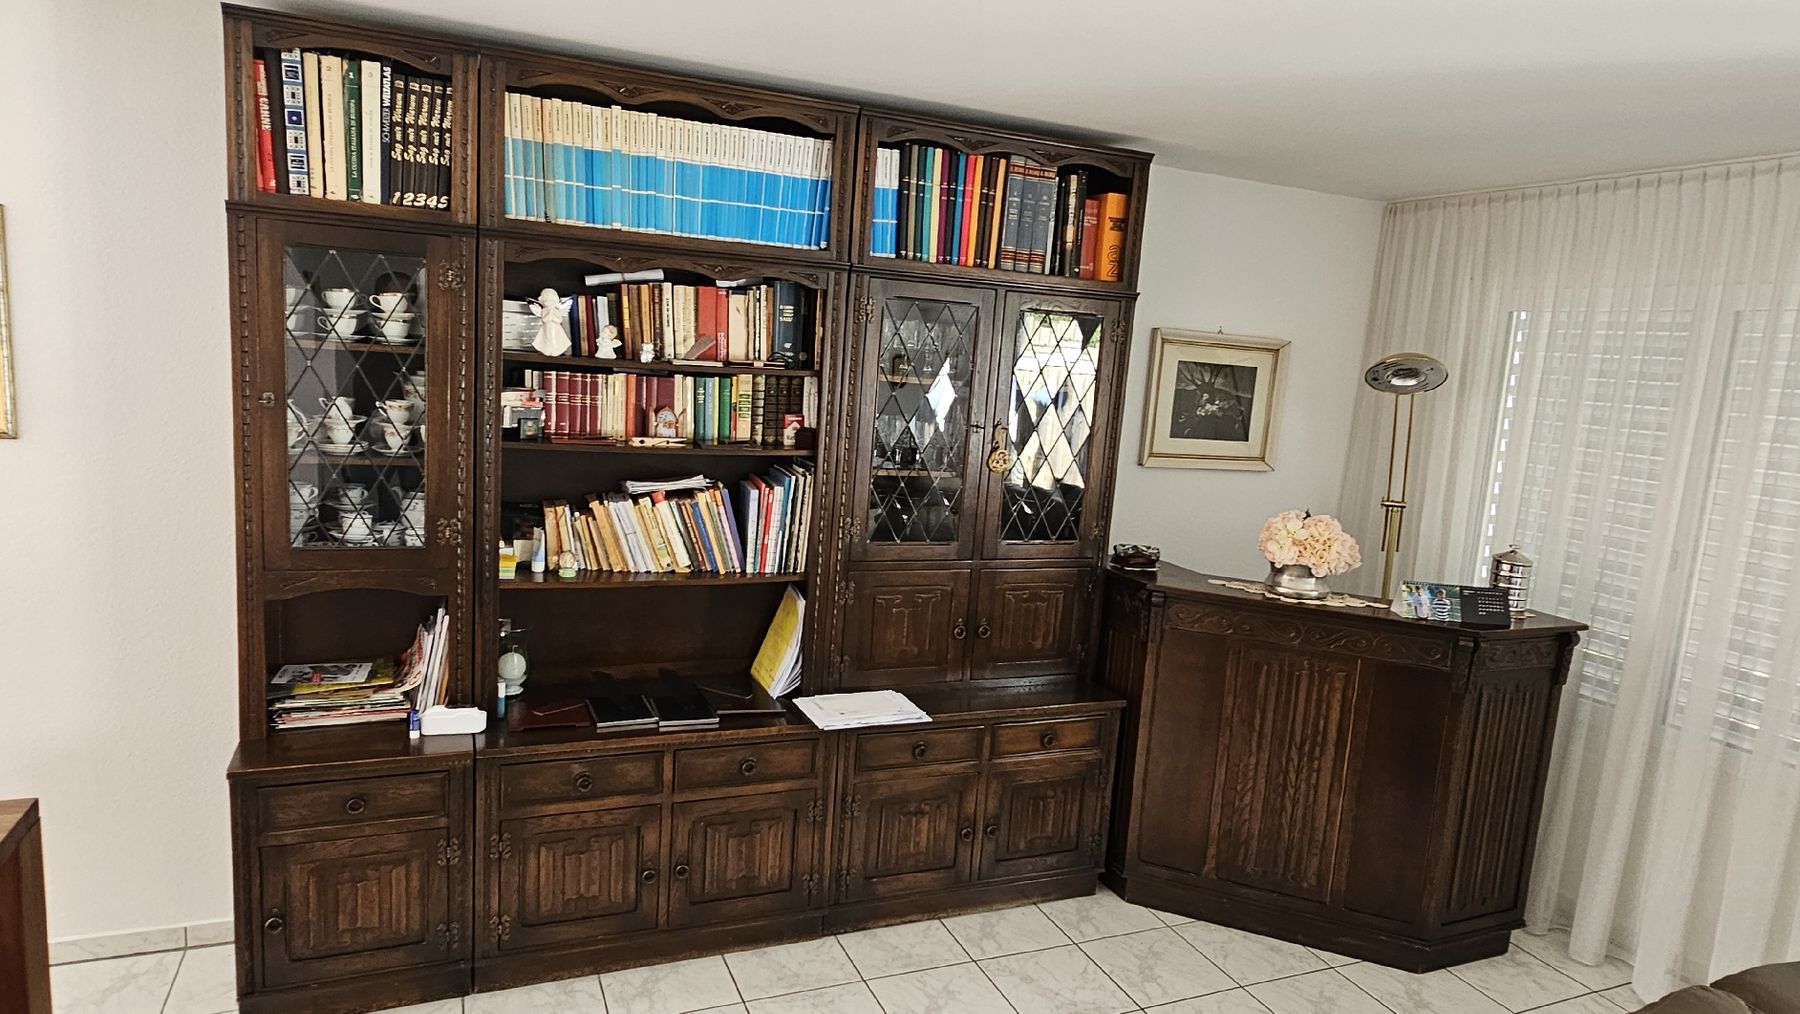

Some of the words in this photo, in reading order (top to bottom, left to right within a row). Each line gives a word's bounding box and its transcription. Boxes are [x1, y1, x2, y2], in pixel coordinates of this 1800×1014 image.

[382, 66, 391, 107] WELTATLAS
[391, 143, 403, 161] Sag
[404, 144, 417, 162] Sag
[416, 146, 429, 164] Sag
[428, 148, 440, 165] Sag
[392, 191, 401, 204] 1
[402, 192, 415, 206] 2
[413, 193, 427, 206] 3
[426, 195, 438, 208] 4
[437, 195, 449, 209] 5
